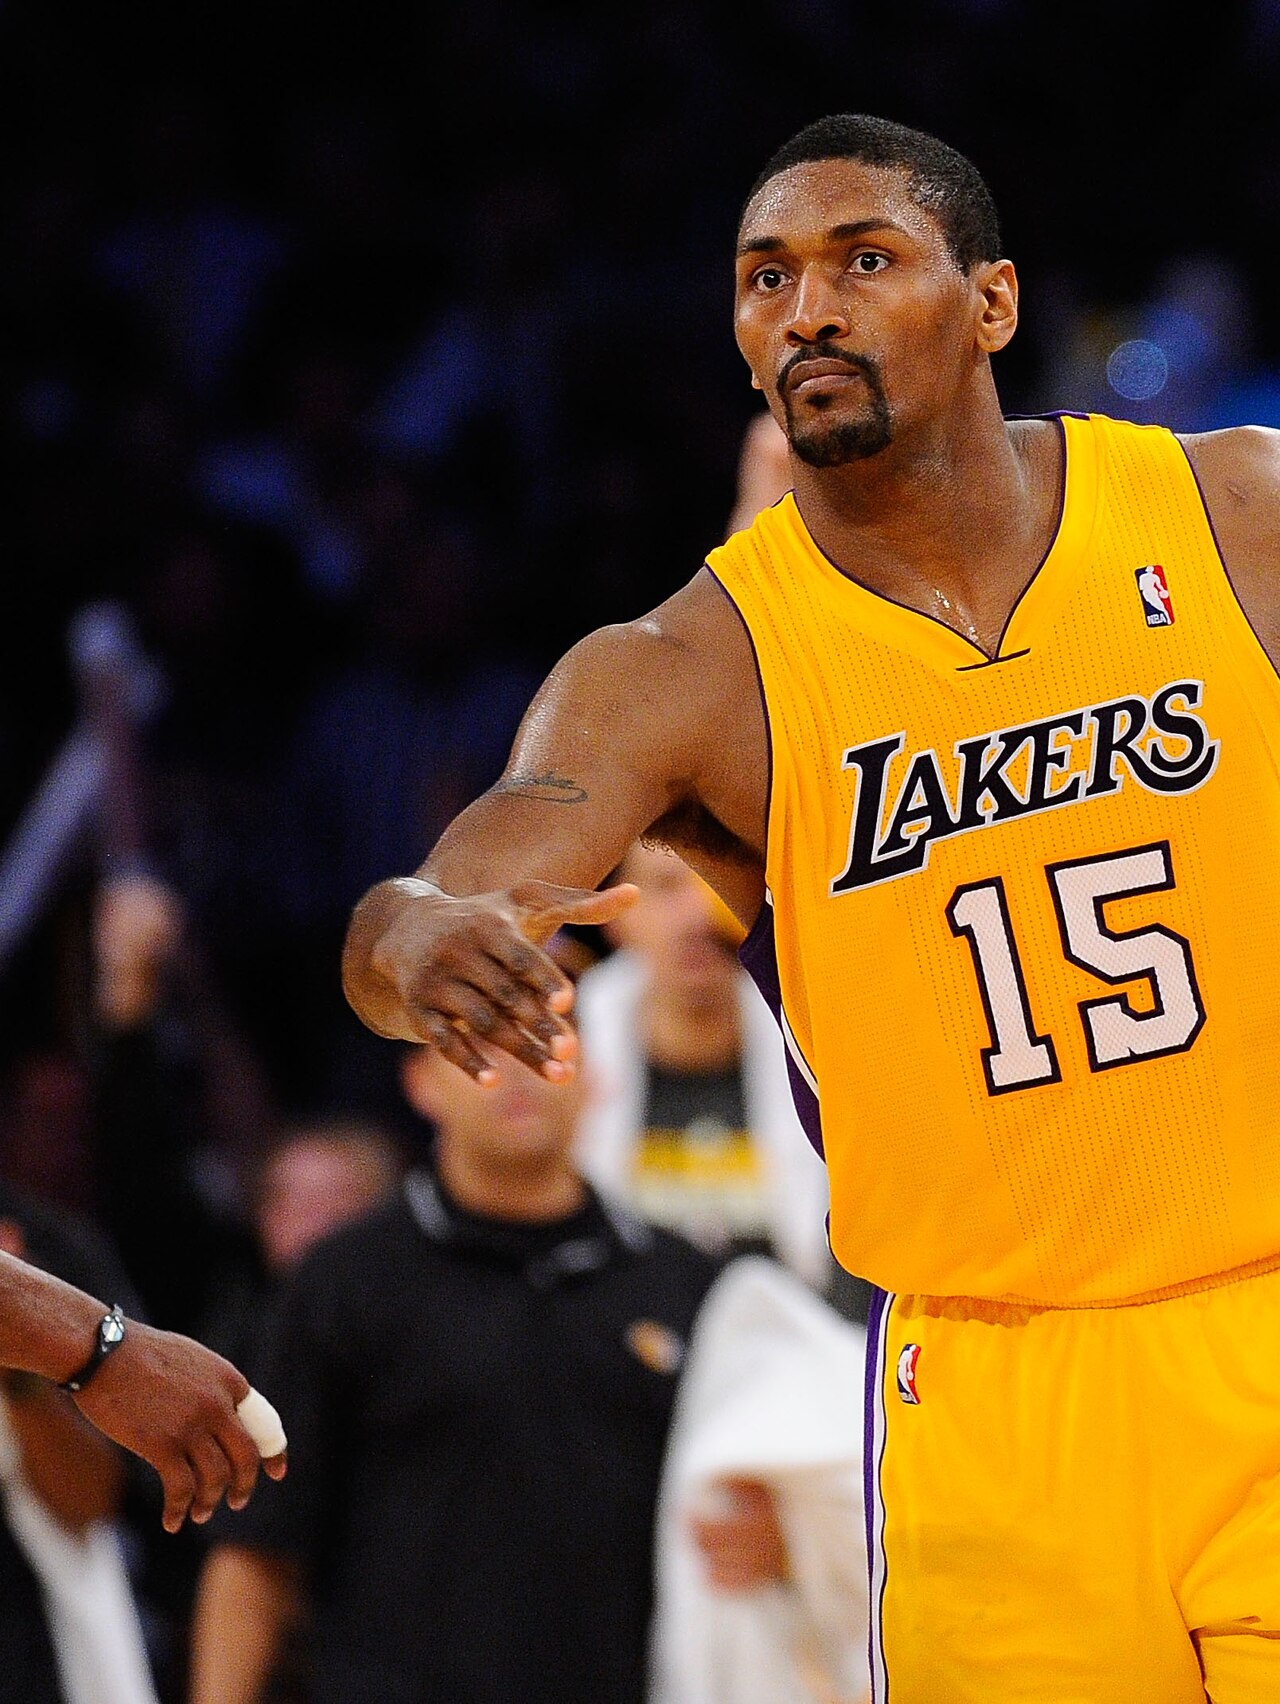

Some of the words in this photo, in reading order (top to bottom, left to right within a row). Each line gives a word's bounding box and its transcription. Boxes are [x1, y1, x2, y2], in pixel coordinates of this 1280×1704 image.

[1147, 613, 1167, 625] NBA
[829, 679, 1221, 897] LAKERS
[945, 841, 1206, 1096] 15
